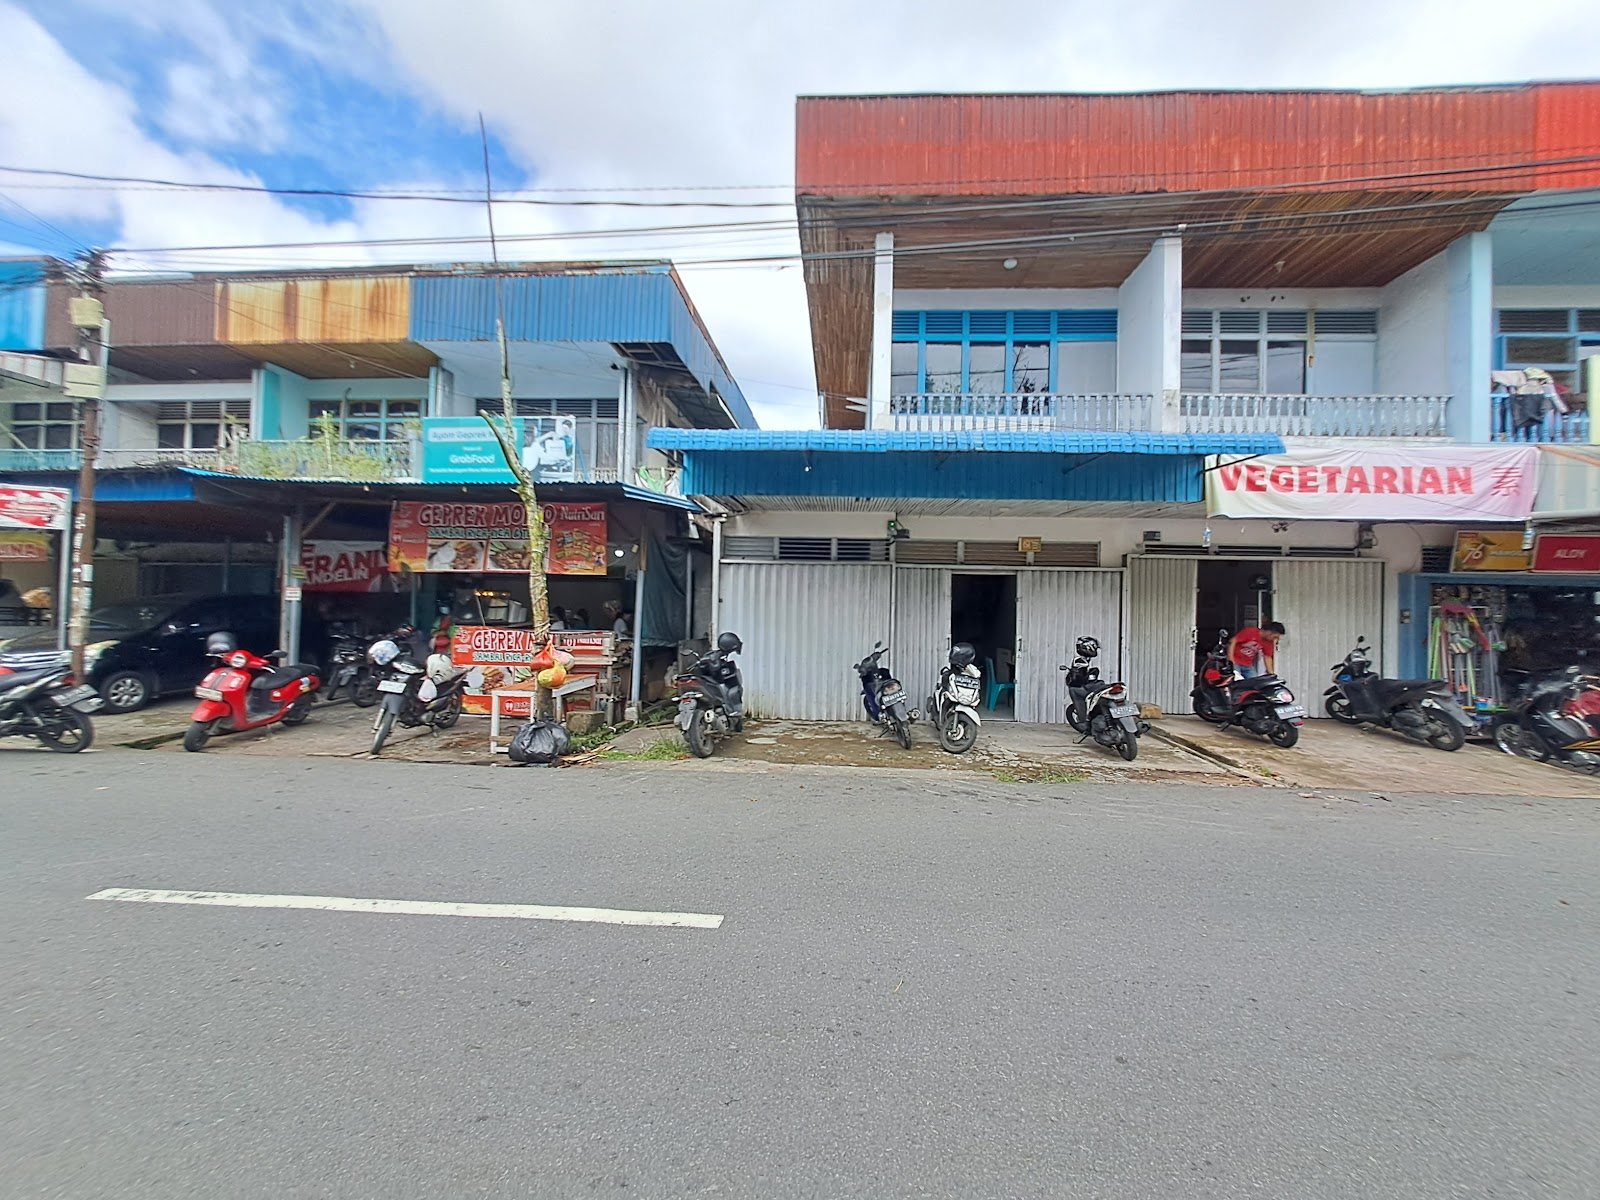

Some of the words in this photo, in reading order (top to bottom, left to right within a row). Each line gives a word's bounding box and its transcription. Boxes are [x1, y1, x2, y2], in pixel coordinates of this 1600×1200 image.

[449, 454, 496, 464] GrabFood
[1218, 464, 1474, 495] VEGETARIAN
[1490, 467, 1523, 496] 素
[418, 504, 488, 527] GEPREK
[491, 503, 556, 527] MOO
[427, 527, 465, 539] SAMBAL
[471, 629, 526, 652] GEPREK
[472, 651, 503, 663] SAMBAL
[504, 653, 534, 663] RICA-RI
